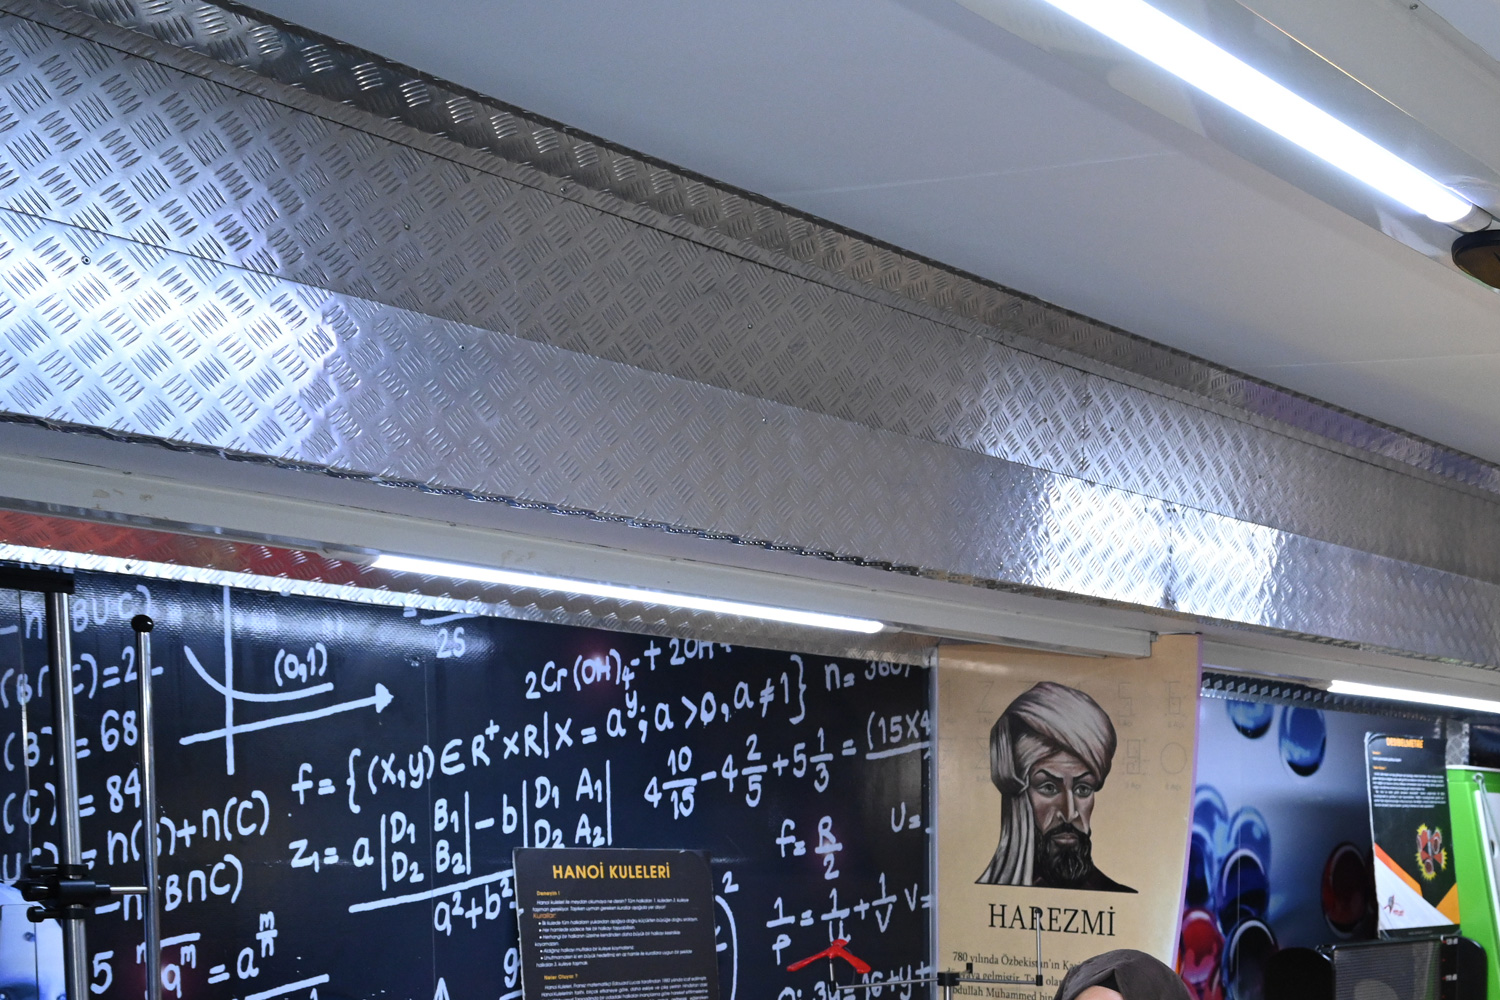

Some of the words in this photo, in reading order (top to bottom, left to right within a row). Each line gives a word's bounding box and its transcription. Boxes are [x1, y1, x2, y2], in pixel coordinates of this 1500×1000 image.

[552, 862, 605, 879] HANOİ
[609, 862, 671, 879] KULELERİ
[988, 903, 1116, 937] HAREZMİ
[952, 951, 968, 962] 780
[952, 985, 984, 997] bdullah
